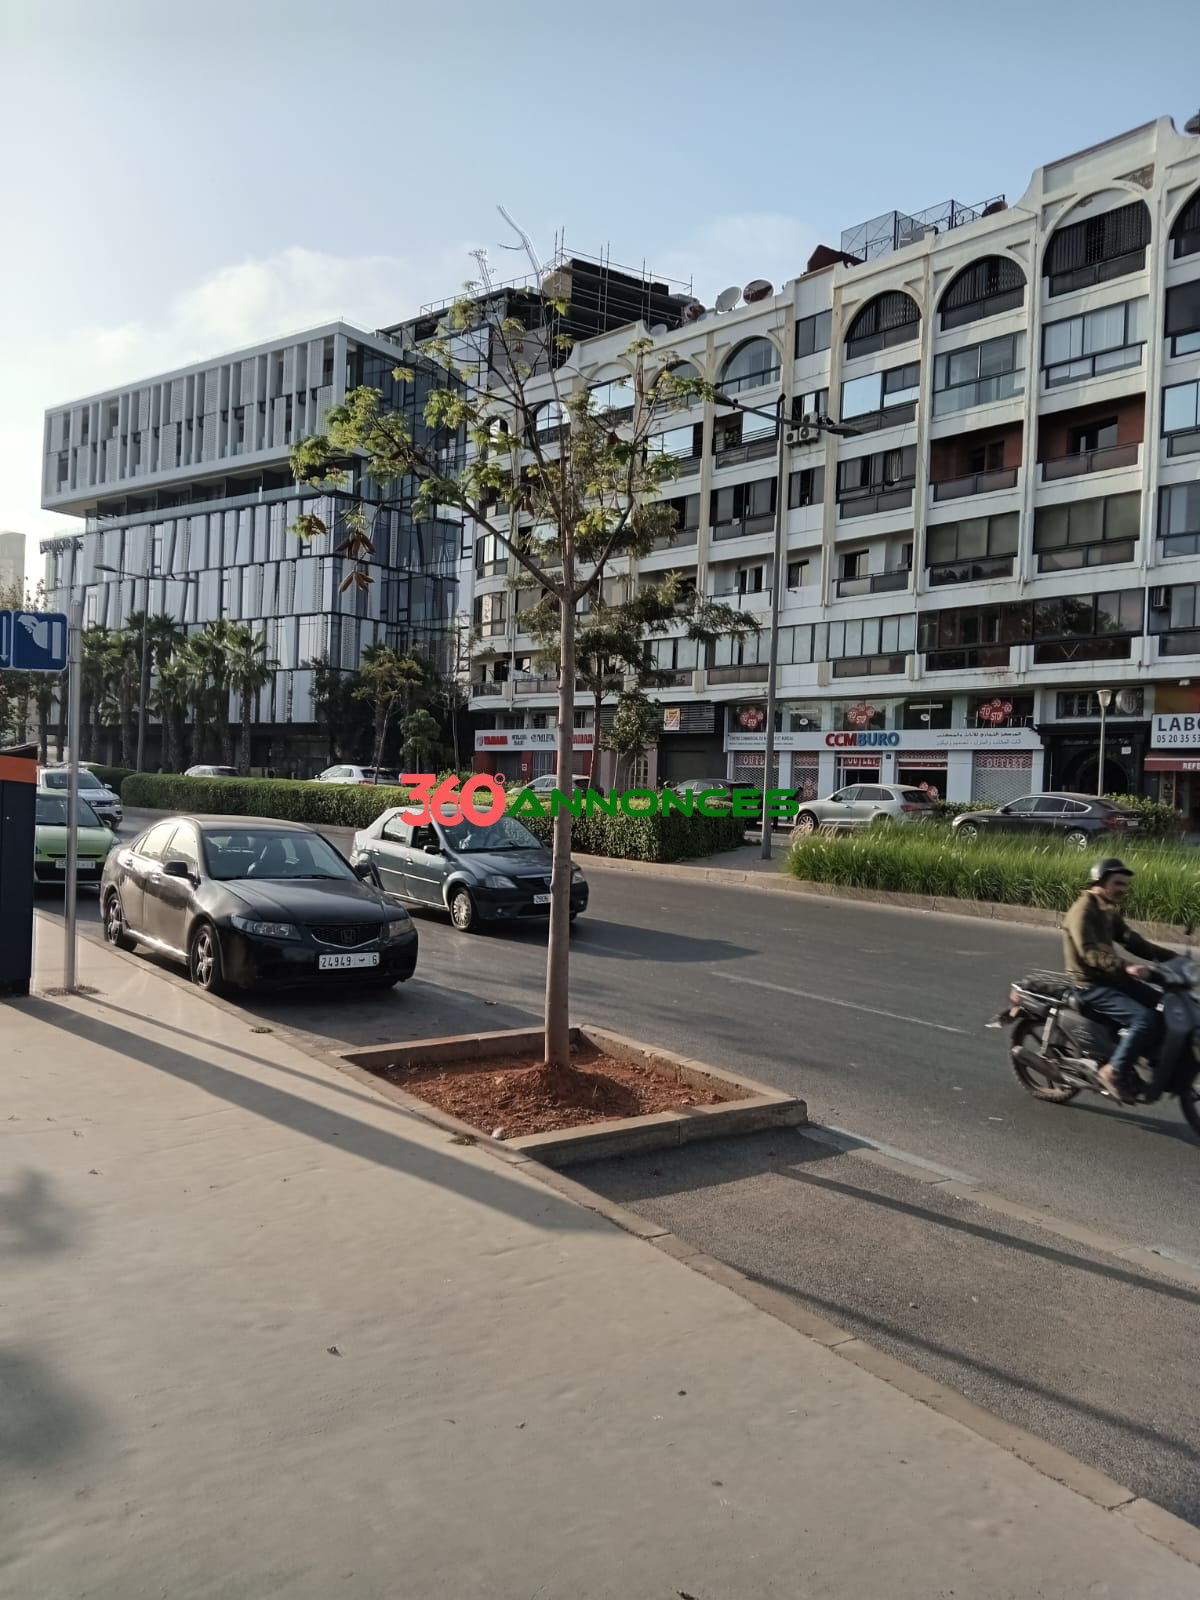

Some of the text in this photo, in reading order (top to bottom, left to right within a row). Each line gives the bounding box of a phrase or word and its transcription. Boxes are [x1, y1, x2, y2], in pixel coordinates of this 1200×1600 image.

[1158, 717, 1200, 731] LAB
[825, 732, 900, 747] CCMBURO
[1157, 734, 1166, 743] 05
[1168, 734, 1178, 743] 20
[1180, 734, 1190, 743] 35
[321, 956, 352, 968] 24949
[372, 954, 377, 965] 6
